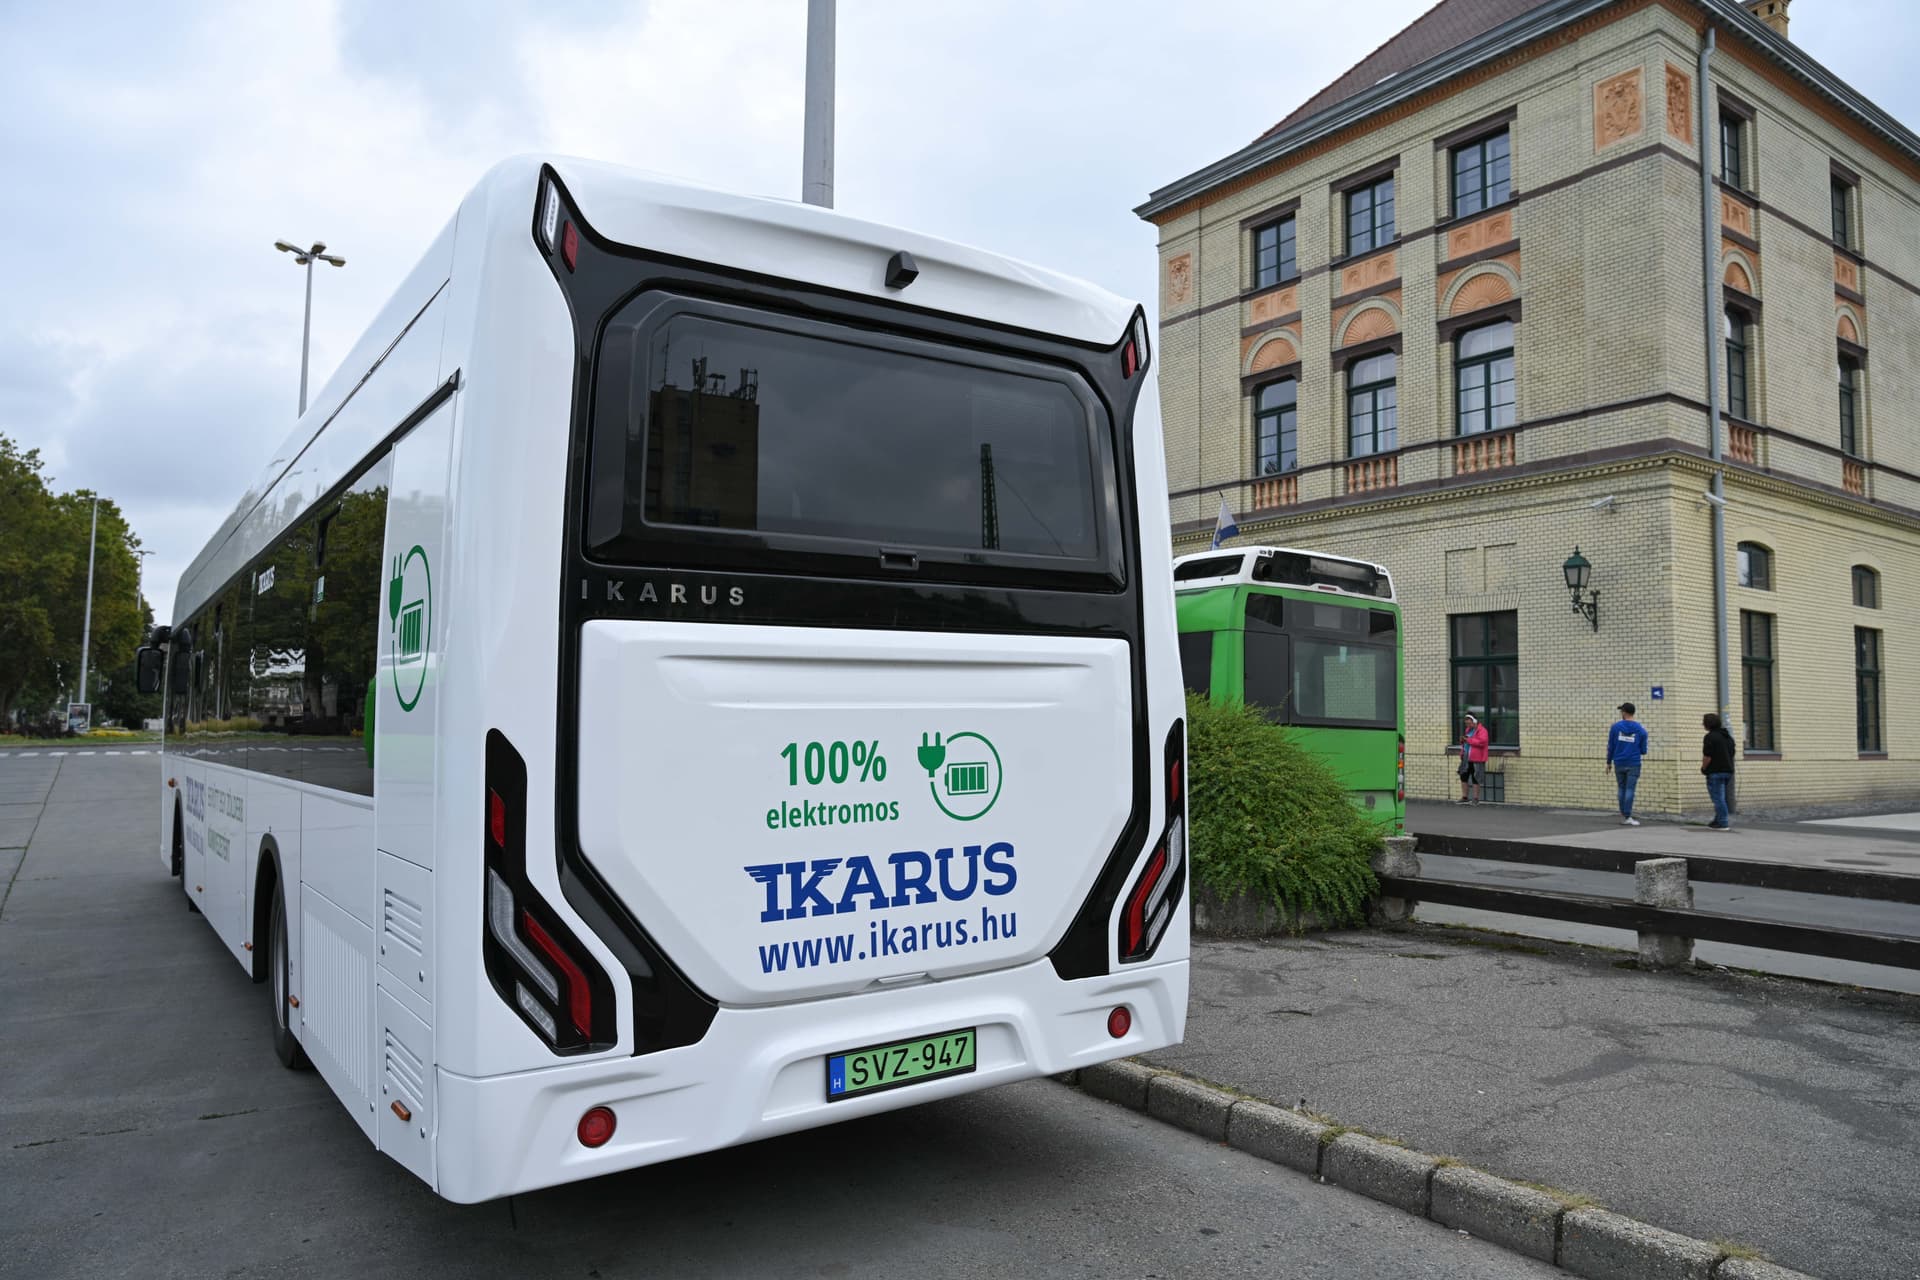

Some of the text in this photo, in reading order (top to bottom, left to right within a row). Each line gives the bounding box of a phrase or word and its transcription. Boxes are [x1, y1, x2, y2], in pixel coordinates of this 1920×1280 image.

[581, 578, 745, 606] IKARUS
[780, 739, 888, 786] 100%
[766, 800, 900, 829] elektromos
[744, 841, 1018, 923] IKARUS
[758, 906, 1017, 974] www.ikarus.hu
[833, 1036, 968, 1089] H SVZ-947
